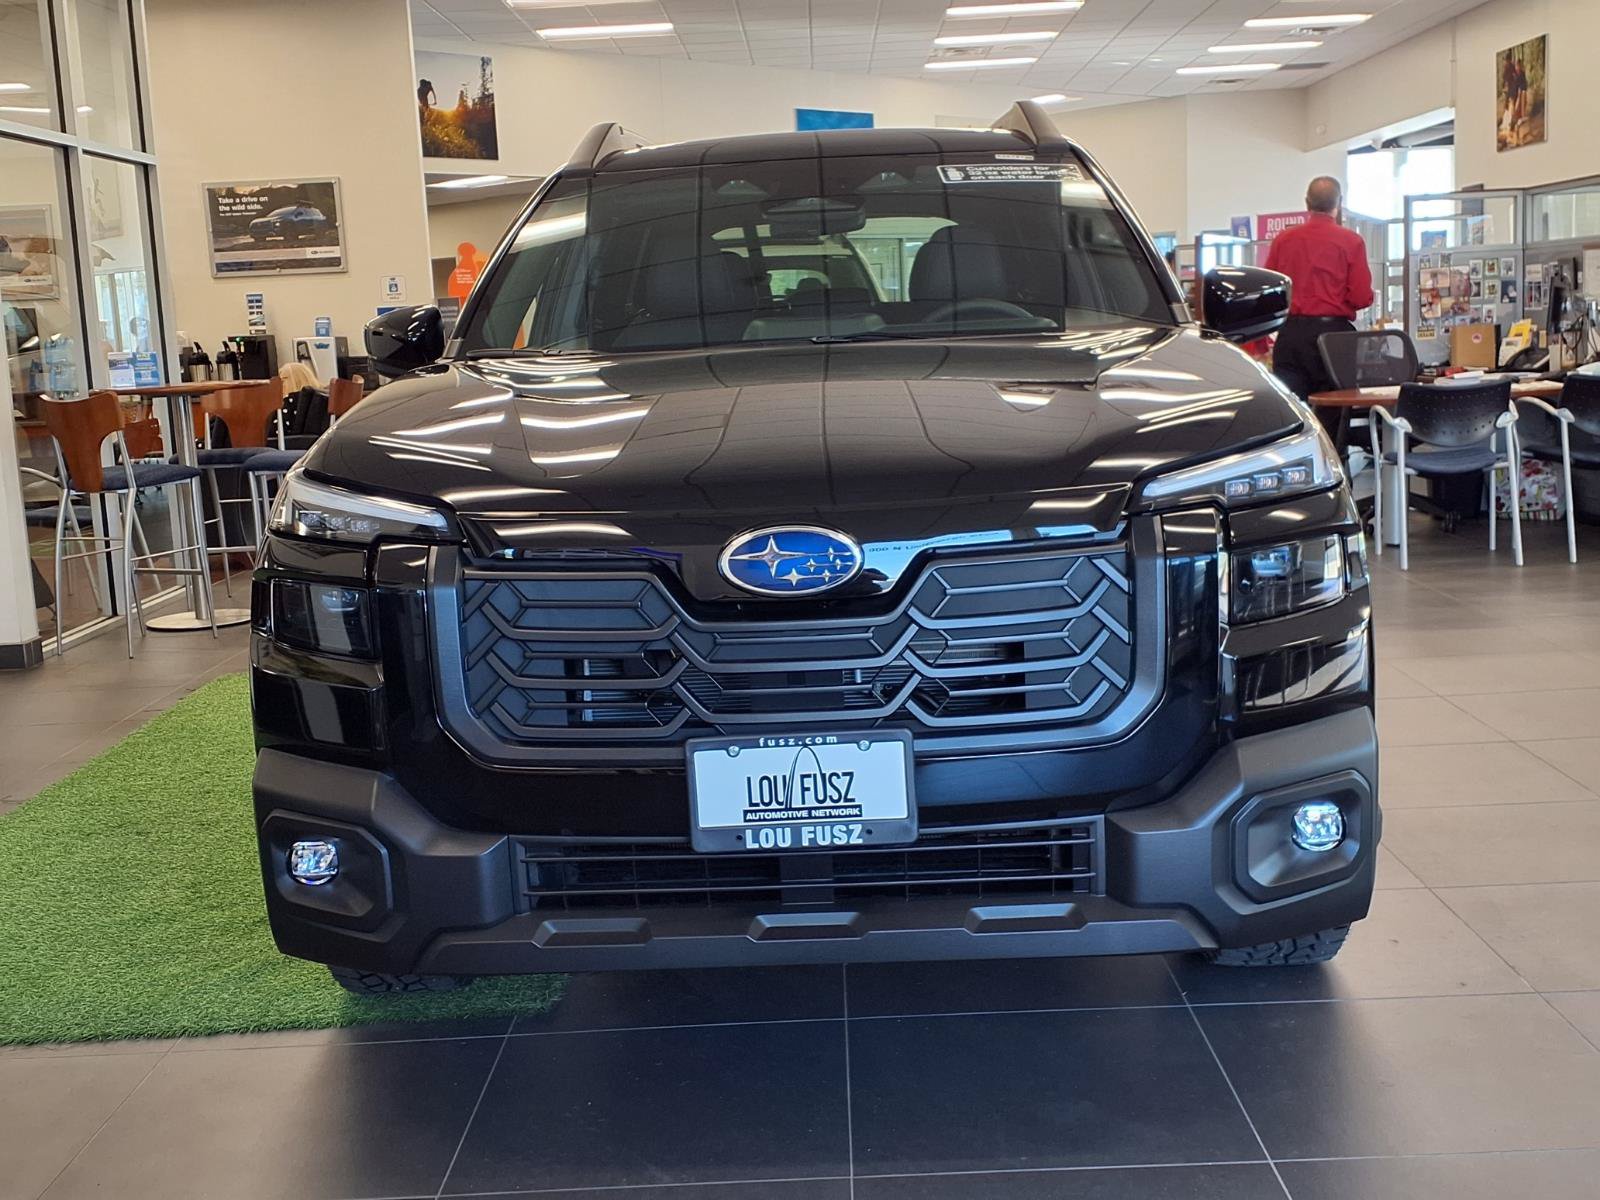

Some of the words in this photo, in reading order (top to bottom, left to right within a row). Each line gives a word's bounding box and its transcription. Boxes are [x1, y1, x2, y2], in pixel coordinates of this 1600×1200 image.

[759, 736, 837, 747] fusz.com
[746, 774, 788, 808] LOU
[799, 771, 856, 805] FUSZ
[745, 809, 809, 820] AUTOMOTIVE
[811, 807, 861, 817] NETWORK
[745, 827, 792, 849] LOU
[801, 823, 864, 847] FUSZ
